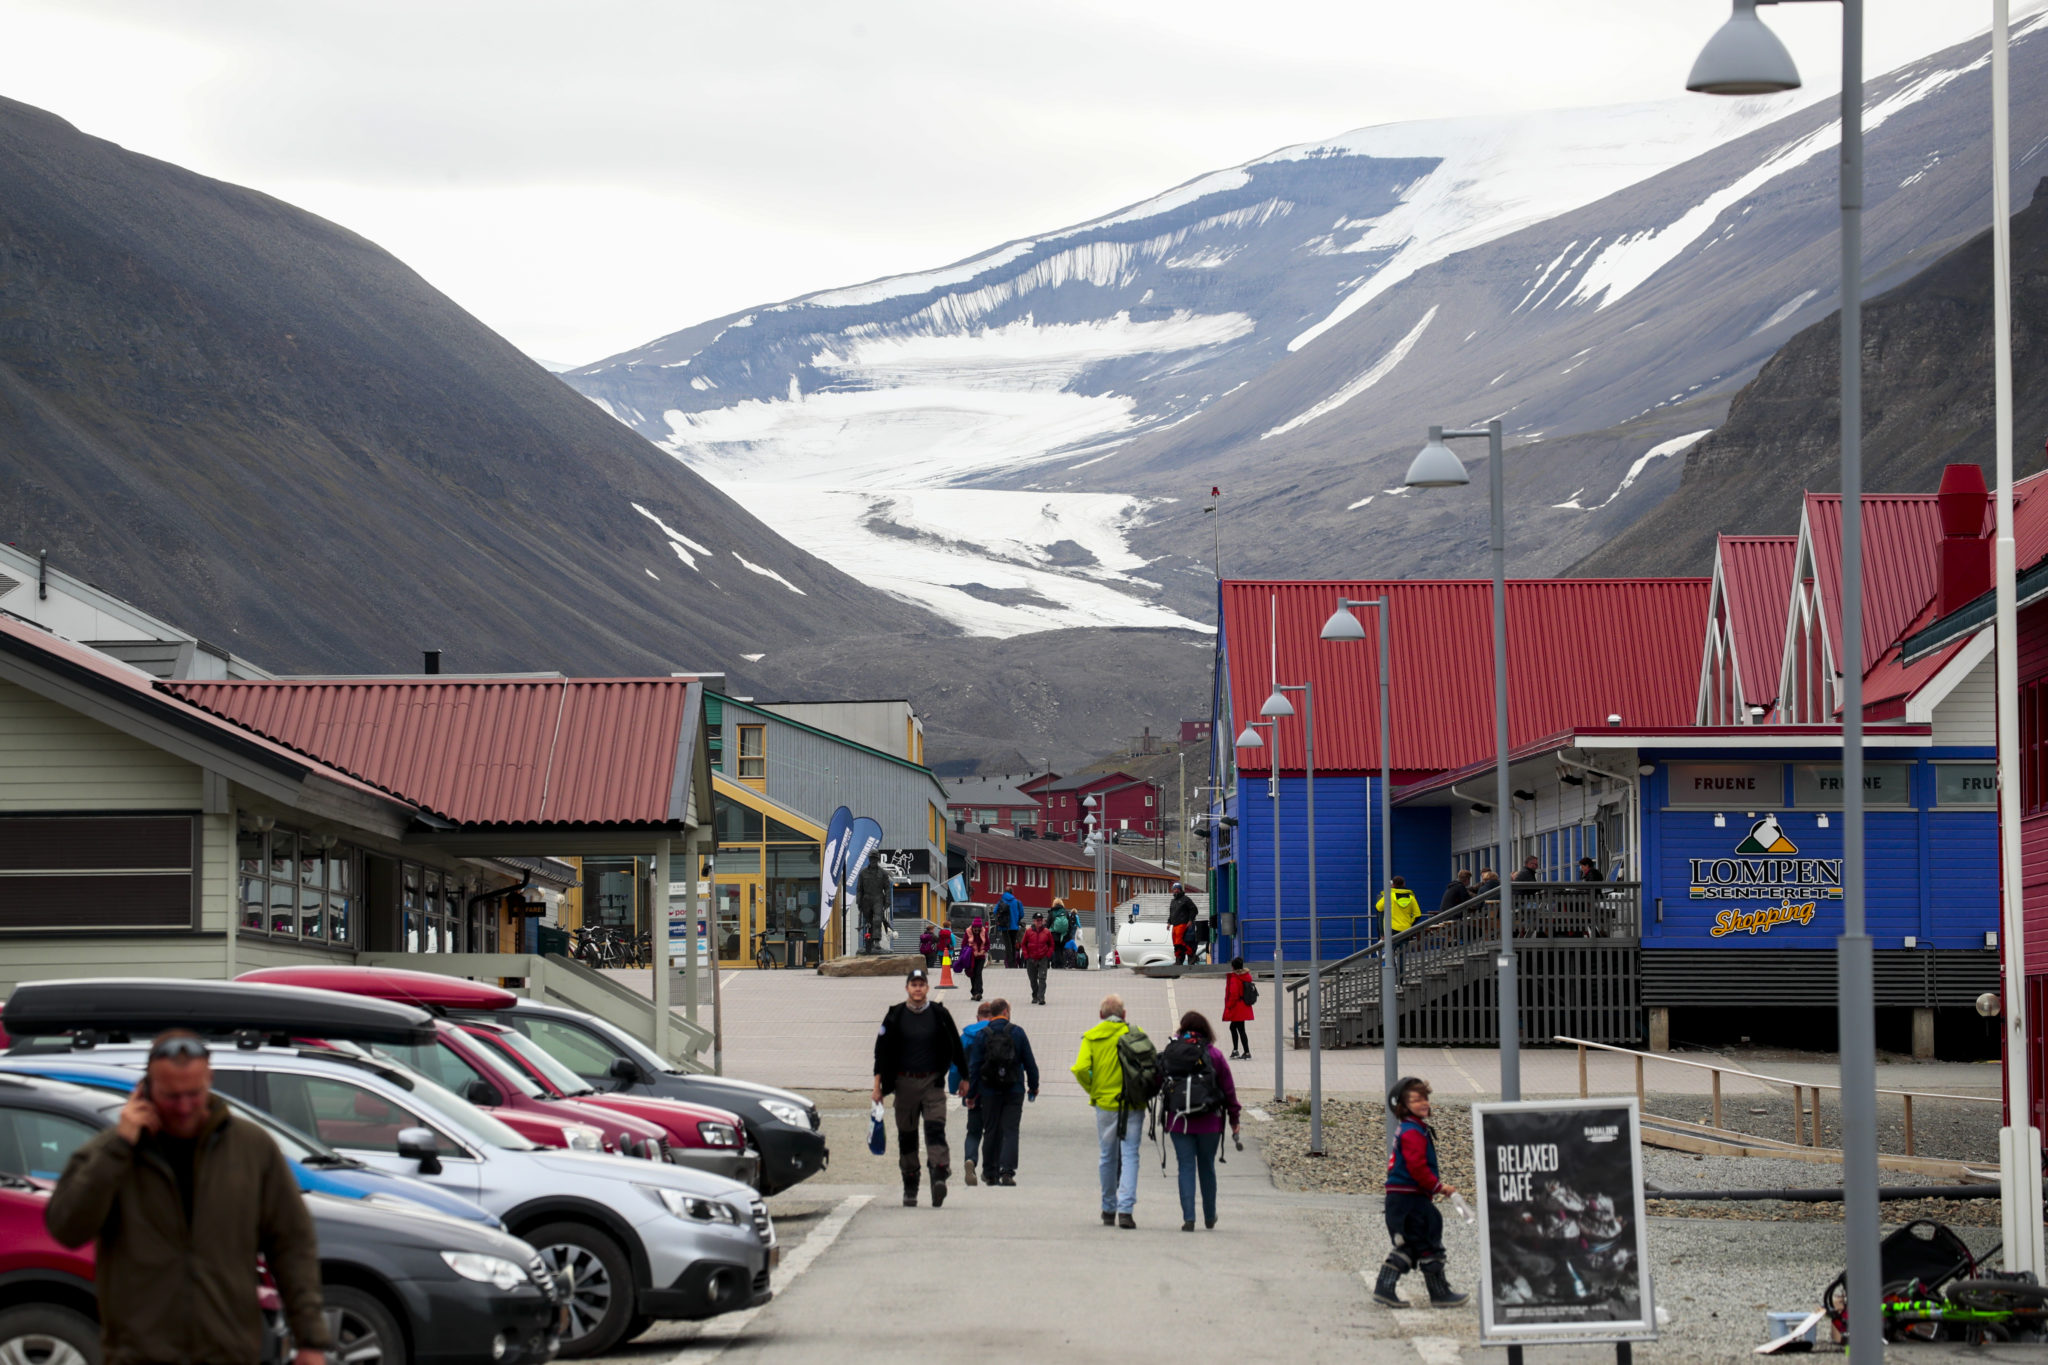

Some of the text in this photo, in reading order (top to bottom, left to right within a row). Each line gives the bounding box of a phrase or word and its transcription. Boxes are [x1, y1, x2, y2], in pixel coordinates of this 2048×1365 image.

[1694, 777, 1756, 790] FRUENE
[1819, 776, 1882, 790] FRNE
[1689, 858, 1843, 885] LOMPEN
[1705, 887, 1828, 899] SENTERET
[1710, 899, 1816, 938] Shopping
[1497, 1143, 1559, 1173] RELAXED
[1499, 1172, 1534, 1202] CAFÉ
